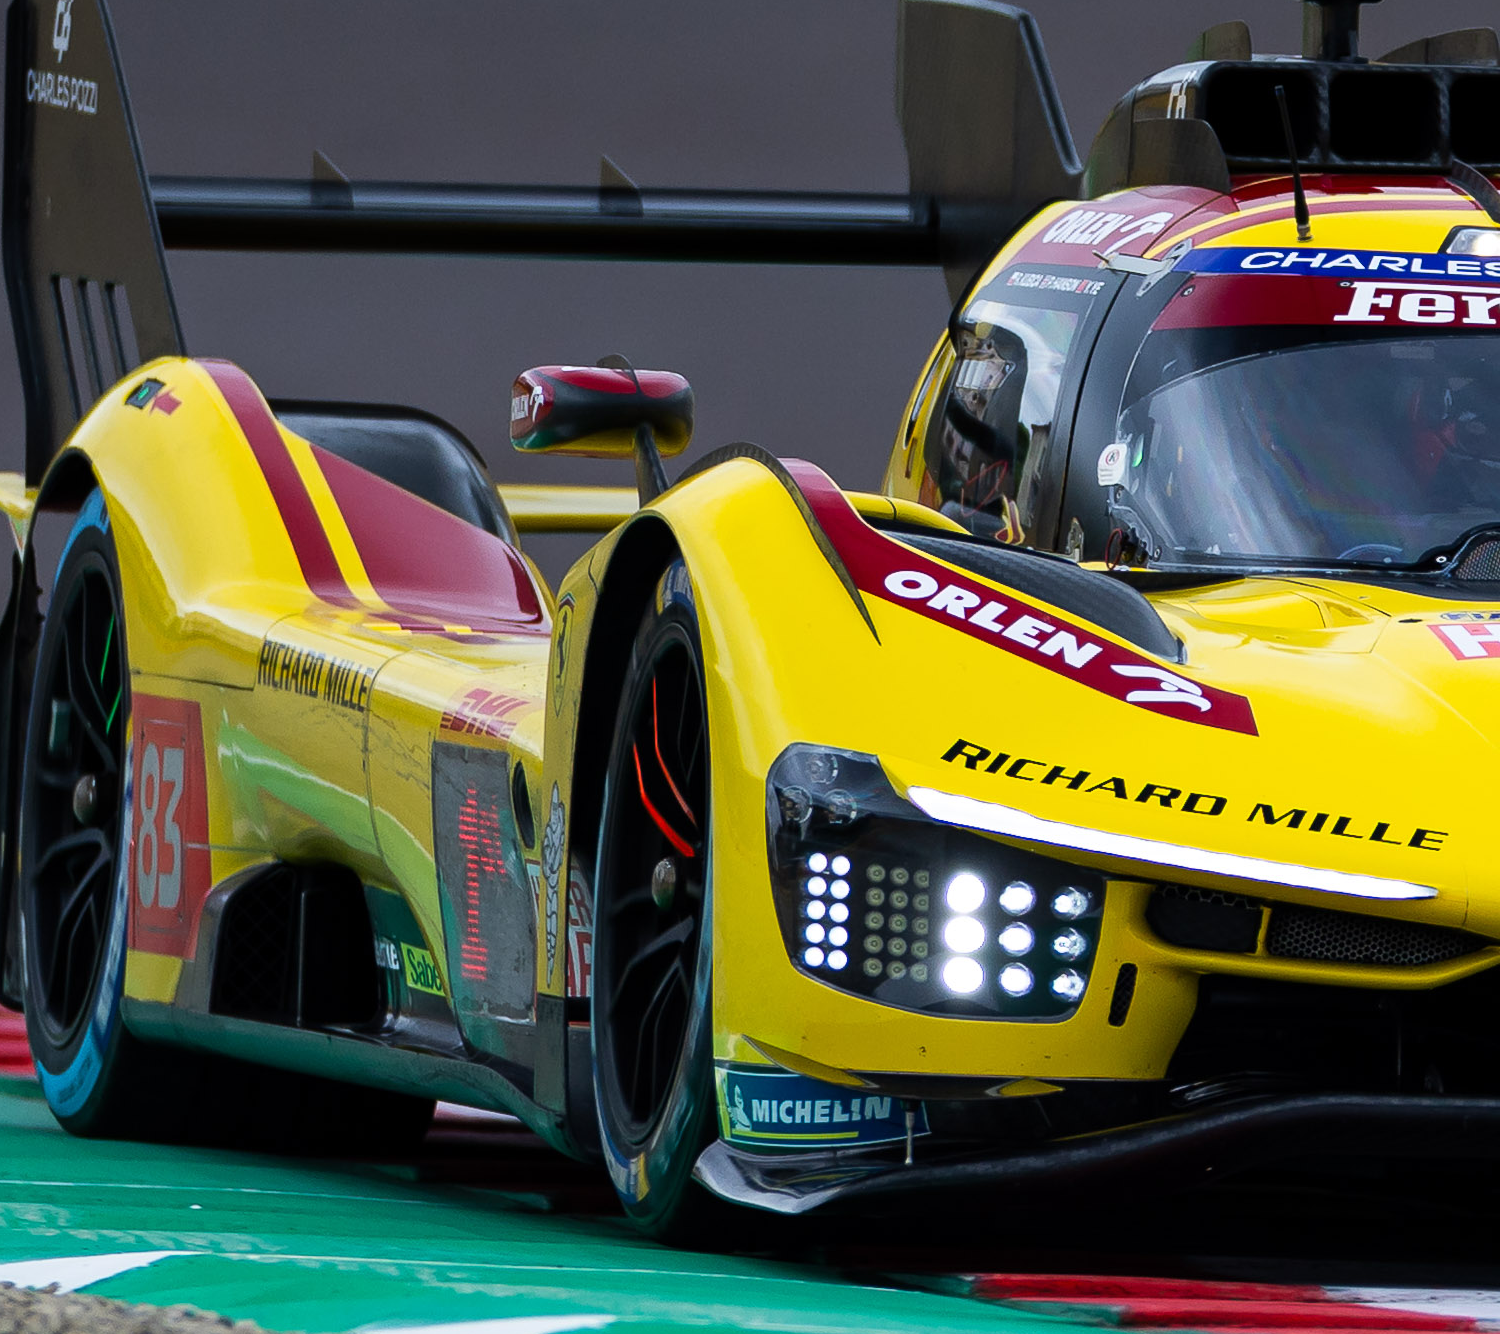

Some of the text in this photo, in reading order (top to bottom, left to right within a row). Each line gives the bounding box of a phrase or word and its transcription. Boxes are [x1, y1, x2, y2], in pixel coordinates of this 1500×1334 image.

[27, 68, 98, 114] CHARLES POZZI
[1042, 209, 1134, 246] ORLEN
[884, 570, 1103, 669] ORLEN
[257, 639, 376, 713] RICHARD MILLE
[137, 741, 185, 909] 83
[939, 738, 1450, 852] RICHARD MILLE
[751, 1096, 892, 1124] MICHELIN
